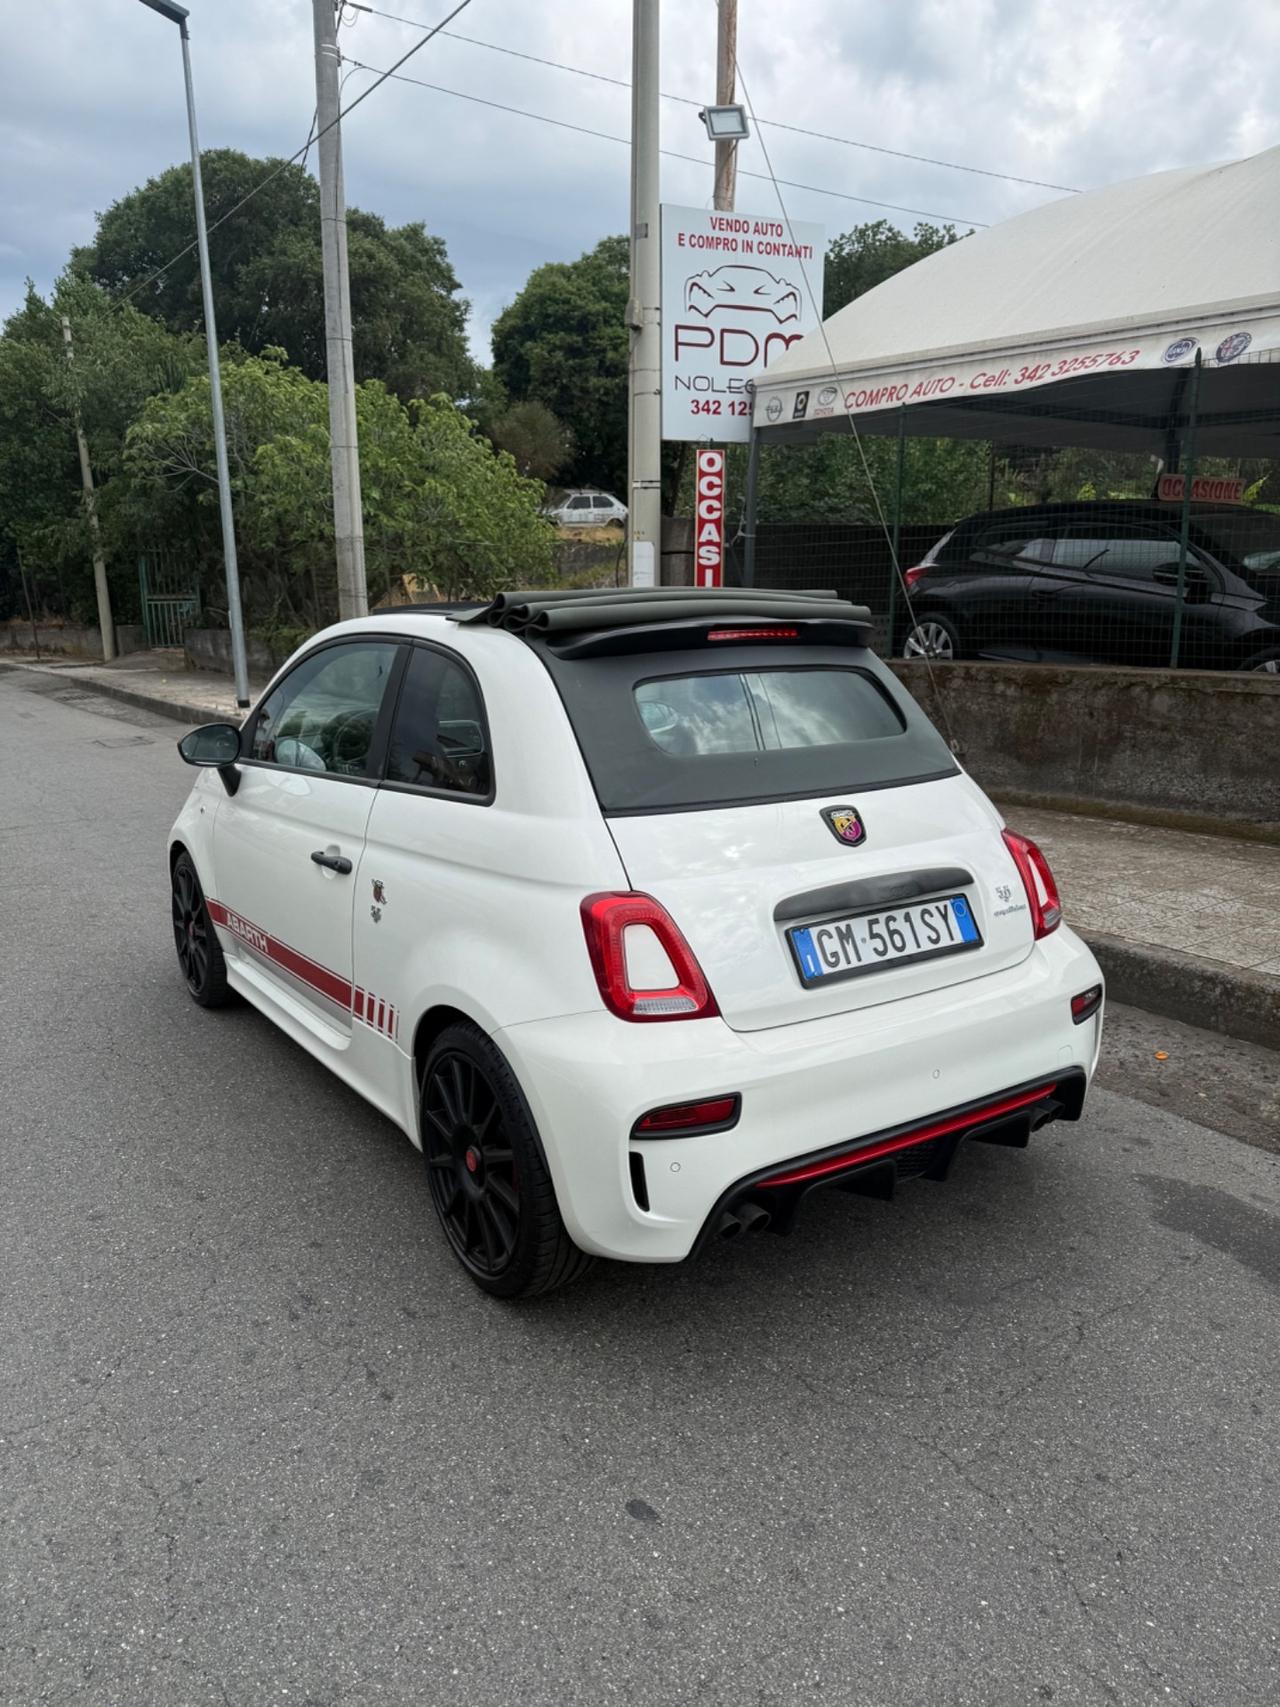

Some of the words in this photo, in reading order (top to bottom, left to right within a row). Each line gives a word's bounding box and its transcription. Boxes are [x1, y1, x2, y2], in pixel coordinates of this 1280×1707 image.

[710, 216, 750, 234] VENDO
[753, 221, 784, 238] AUTO
[678, 233, 686, 247] E
[688, 234, 739, 252] COMPRO
[741, 239, 754, 254] IN
[757, 241, 813, 259] CONTANTI
[844, 383, 909, 409] COMPRO
[909, 376, 956, 399] AUTO
[969, 369, 1012, 390] Cell:
[1014, 363, 1051, 385] 342
[1051, 350, 1140, 377] 3255763
[690, 399, 722, 415] 342
[1162, 478, 1242, 500] OCASIONE
[227, 913, 269, 953] ABARTH
[816, 923, 862, 968] GM
[866, 904, 955, 957] 561SY
